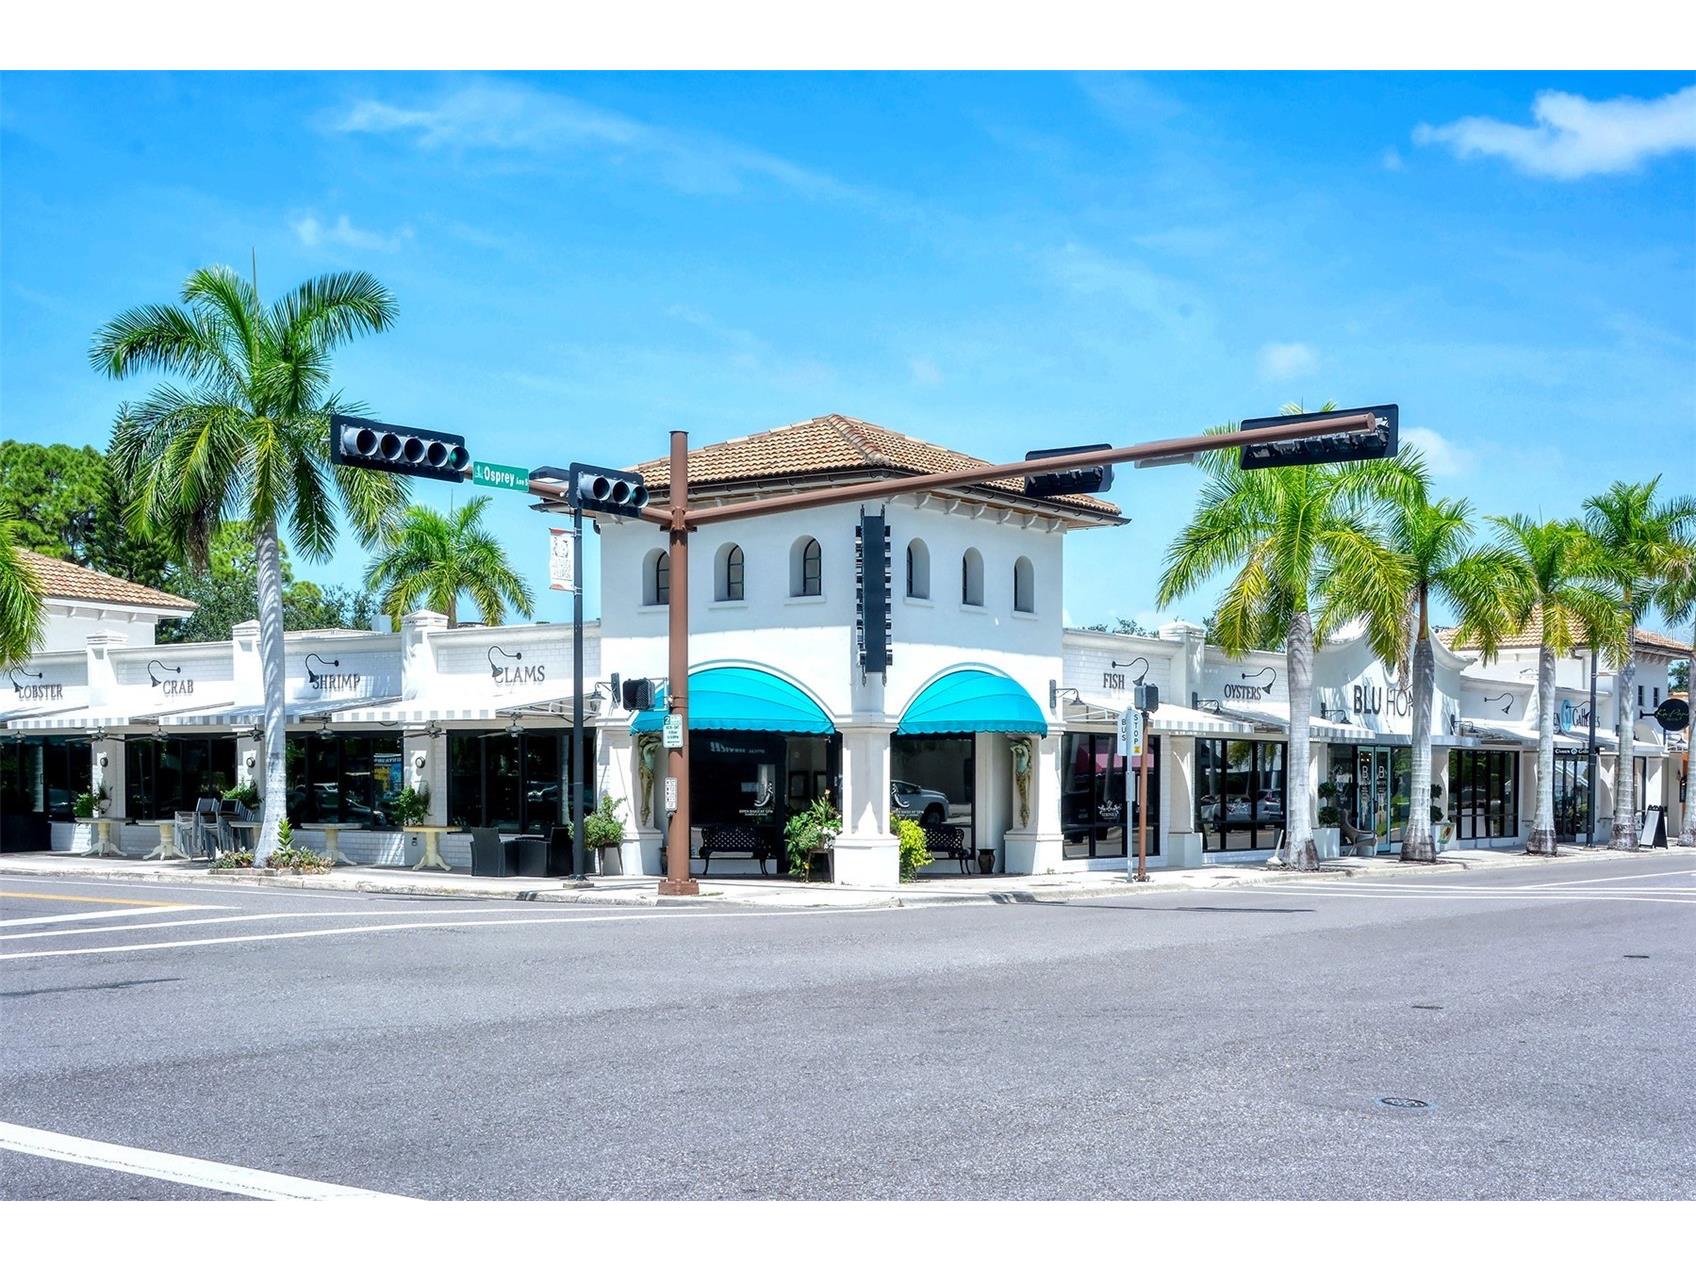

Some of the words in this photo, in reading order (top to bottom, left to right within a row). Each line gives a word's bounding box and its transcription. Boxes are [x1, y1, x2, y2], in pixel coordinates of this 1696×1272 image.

[484, 466, 514, 487] Osprey
[312, 674, 361, 690] SHRIMP
[495, 665, 545, 683] CLAMS
[1103, 672, 1125, 689] FISH
[18, 684, 63, 699] LOBSTER
[163, 680, 194, 695] CRAB
[1224, 684, 1262, 700] OYSTERS
[1354, 685, 1382, 715] BLU
